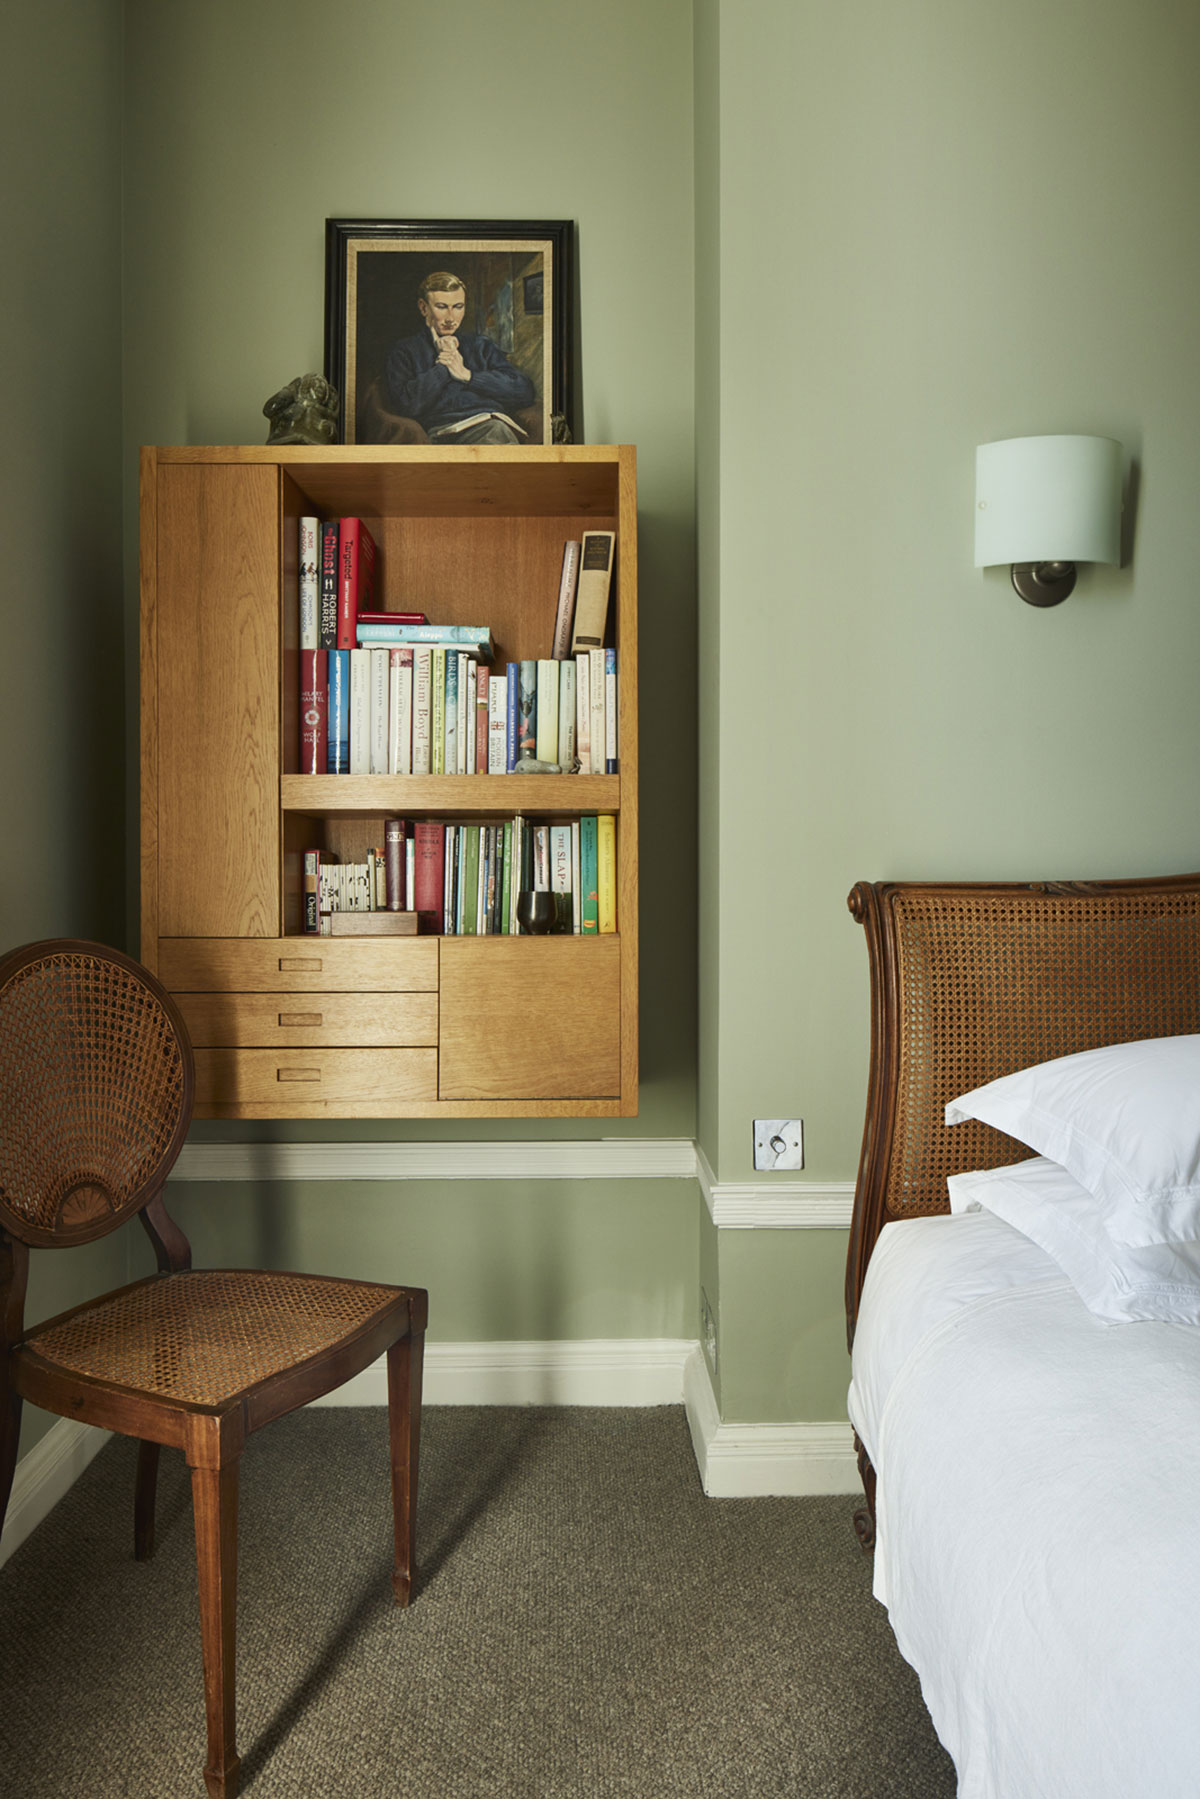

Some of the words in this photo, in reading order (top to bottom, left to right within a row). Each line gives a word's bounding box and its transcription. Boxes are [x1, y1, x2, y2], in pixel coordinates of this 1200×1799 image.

[323, 536, 337, 575] Ghost
[343, 540, 354, 580] Targeted
[321, 594, 329, 635] HARRIS
[329, 594, 337, 635] ROBERT
[418, 654, 430, 703] William
[447, 656, 457, 686] BIRDS
[414, 709, 429, 740] Boyd
[557, 851, 566, 880] SLAP
[307, 896, 316, 926] Original
